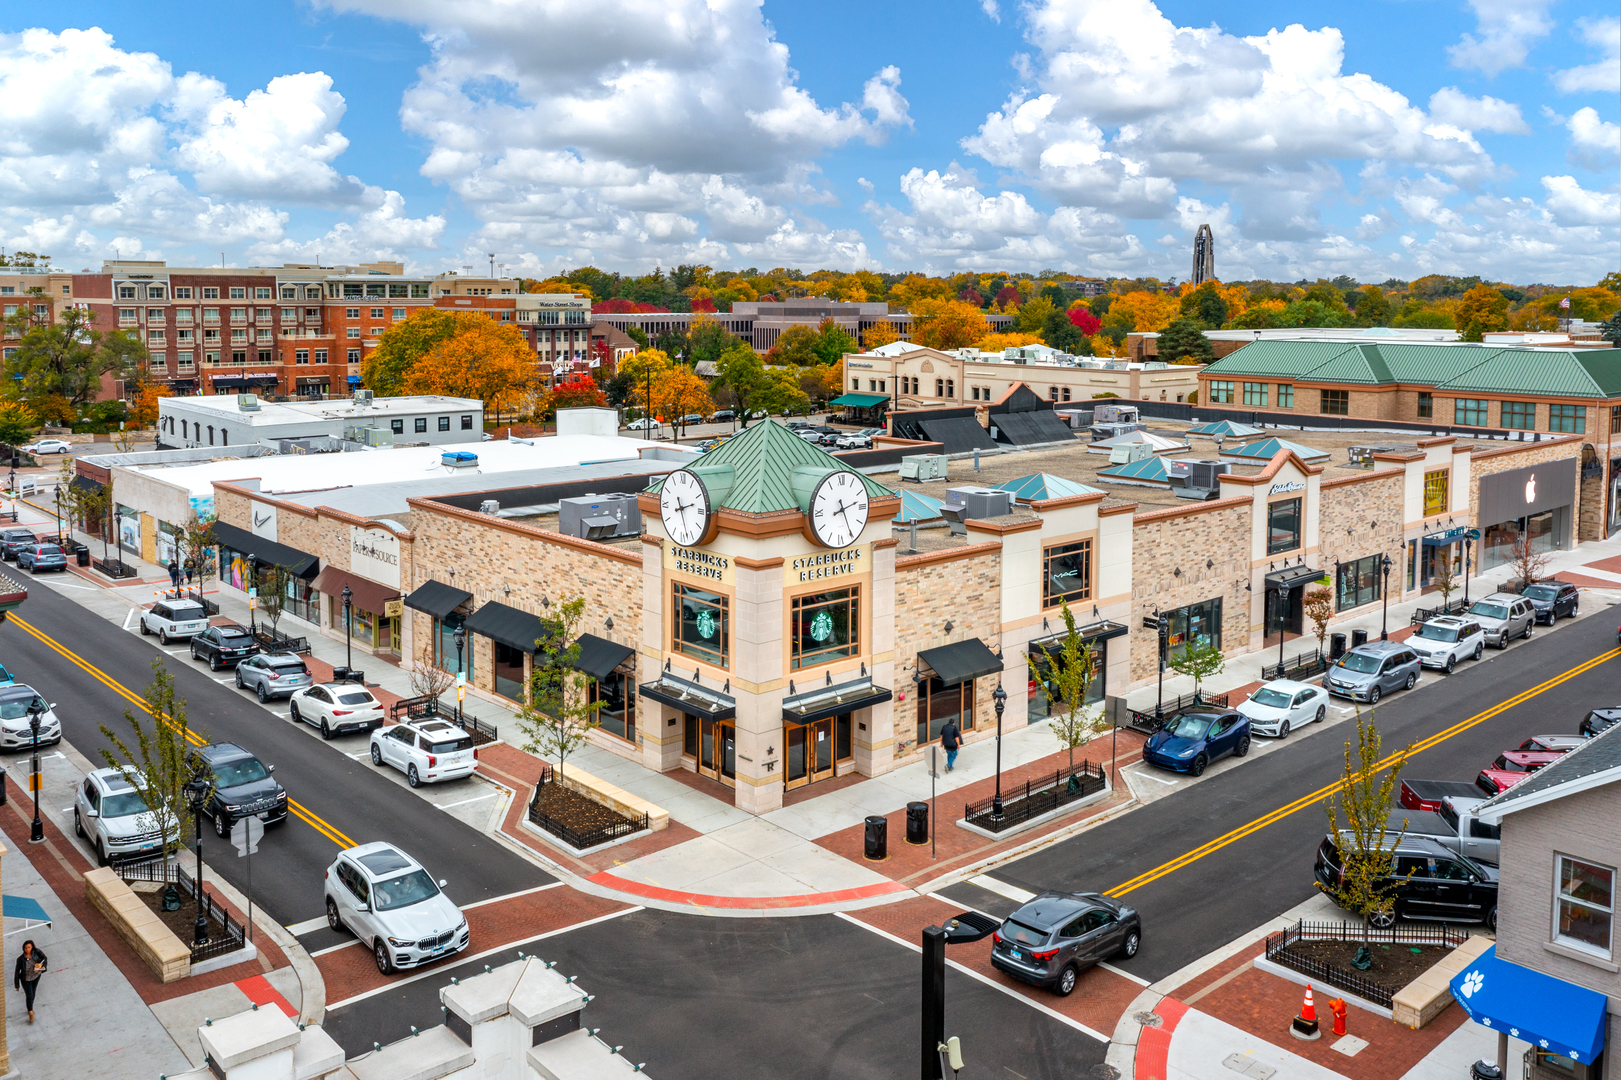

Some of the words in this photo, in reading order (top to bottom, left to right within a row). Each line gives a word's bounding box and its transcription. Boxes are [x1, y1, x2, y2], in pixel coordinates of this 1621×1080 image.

[375, 549, 398, 566] SOURCE
[671, 546, 728, 569] STARBUCKS
[793, 549, 862, 570] STARBUCKS
[676, 560, 722, 581] RESERVE
[800, 563, 855, 581] RESERVE
[767, 763, 774, 772] R
